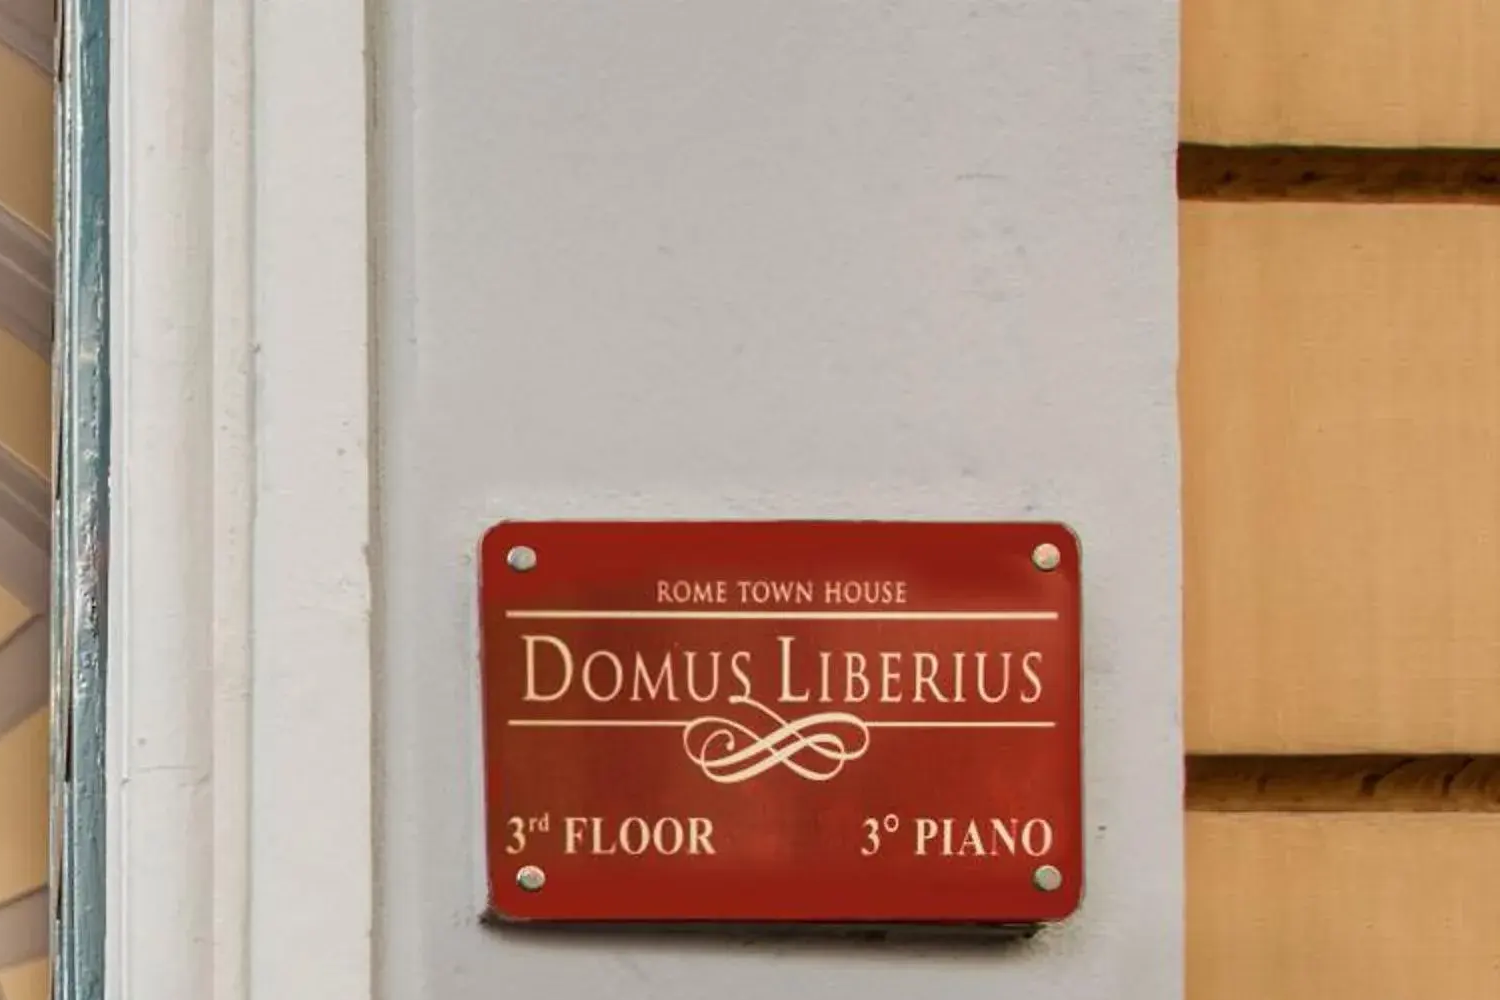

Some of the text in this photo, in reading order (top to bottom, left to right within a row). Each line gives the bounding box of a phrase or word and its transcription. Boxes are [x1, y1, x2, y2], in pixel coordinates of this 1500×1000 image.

[657, 581, 907, 604] ROME TOWN HOUSE
[778, 636, 1043, 703] LIBERIUS
[506, 813, 716, 855] 3rd FLOOR
[916, 818, 1053, 857] PIANO
